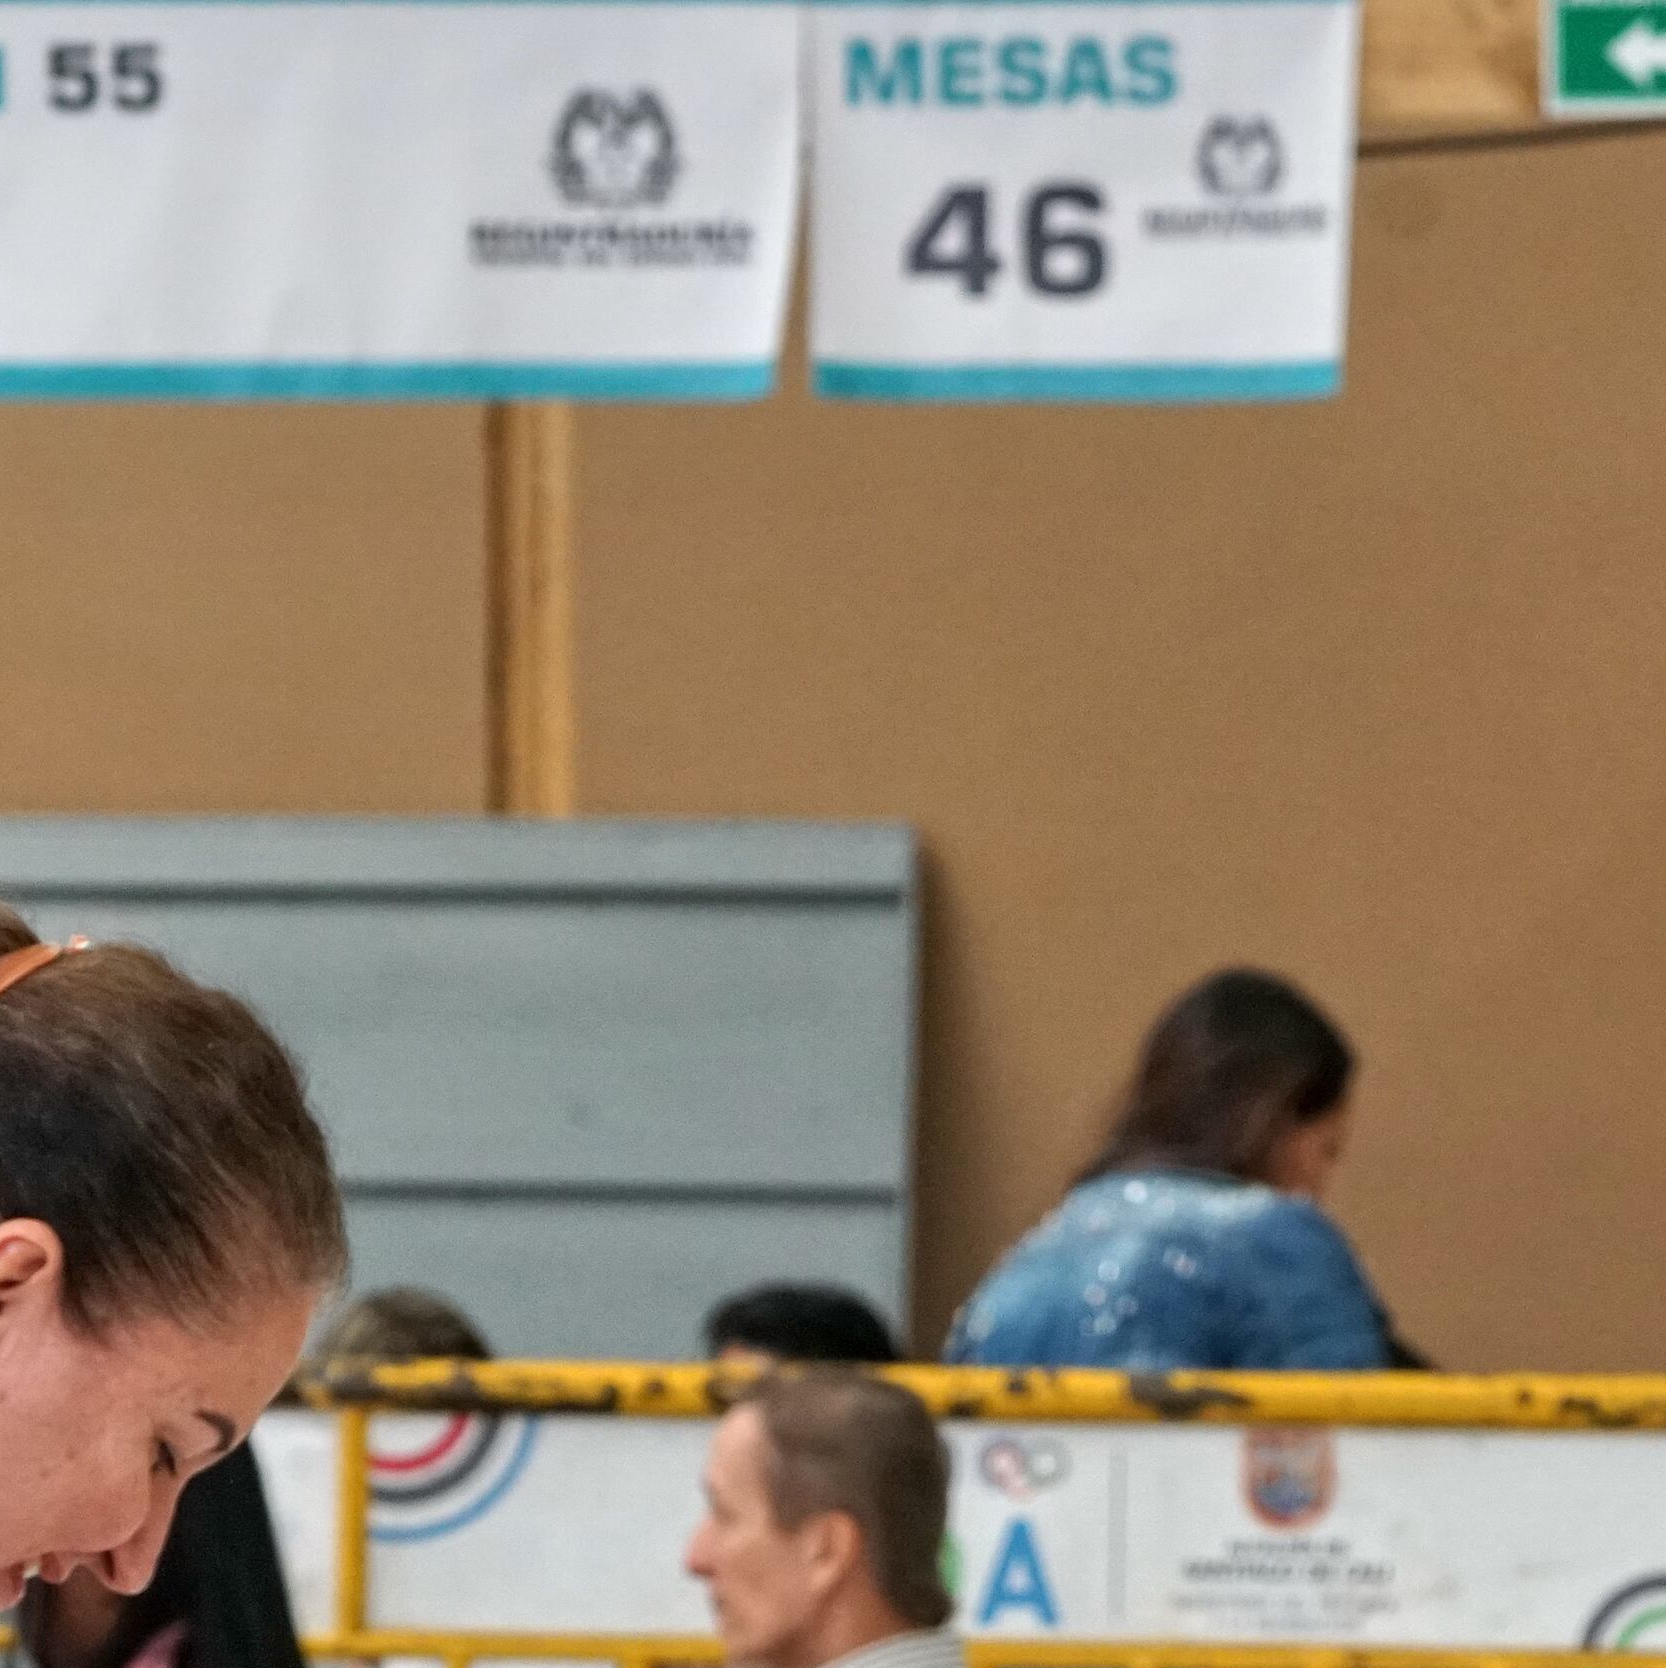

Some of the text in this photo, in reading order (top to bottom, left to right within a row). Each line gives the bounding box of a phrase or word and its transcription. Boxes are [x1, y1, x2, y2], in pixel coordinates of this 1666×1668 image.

[45, 42, 165, 115] 55
[843, 34, 1179, 109] MESAS
[903, 178, 1111, 301] 46
